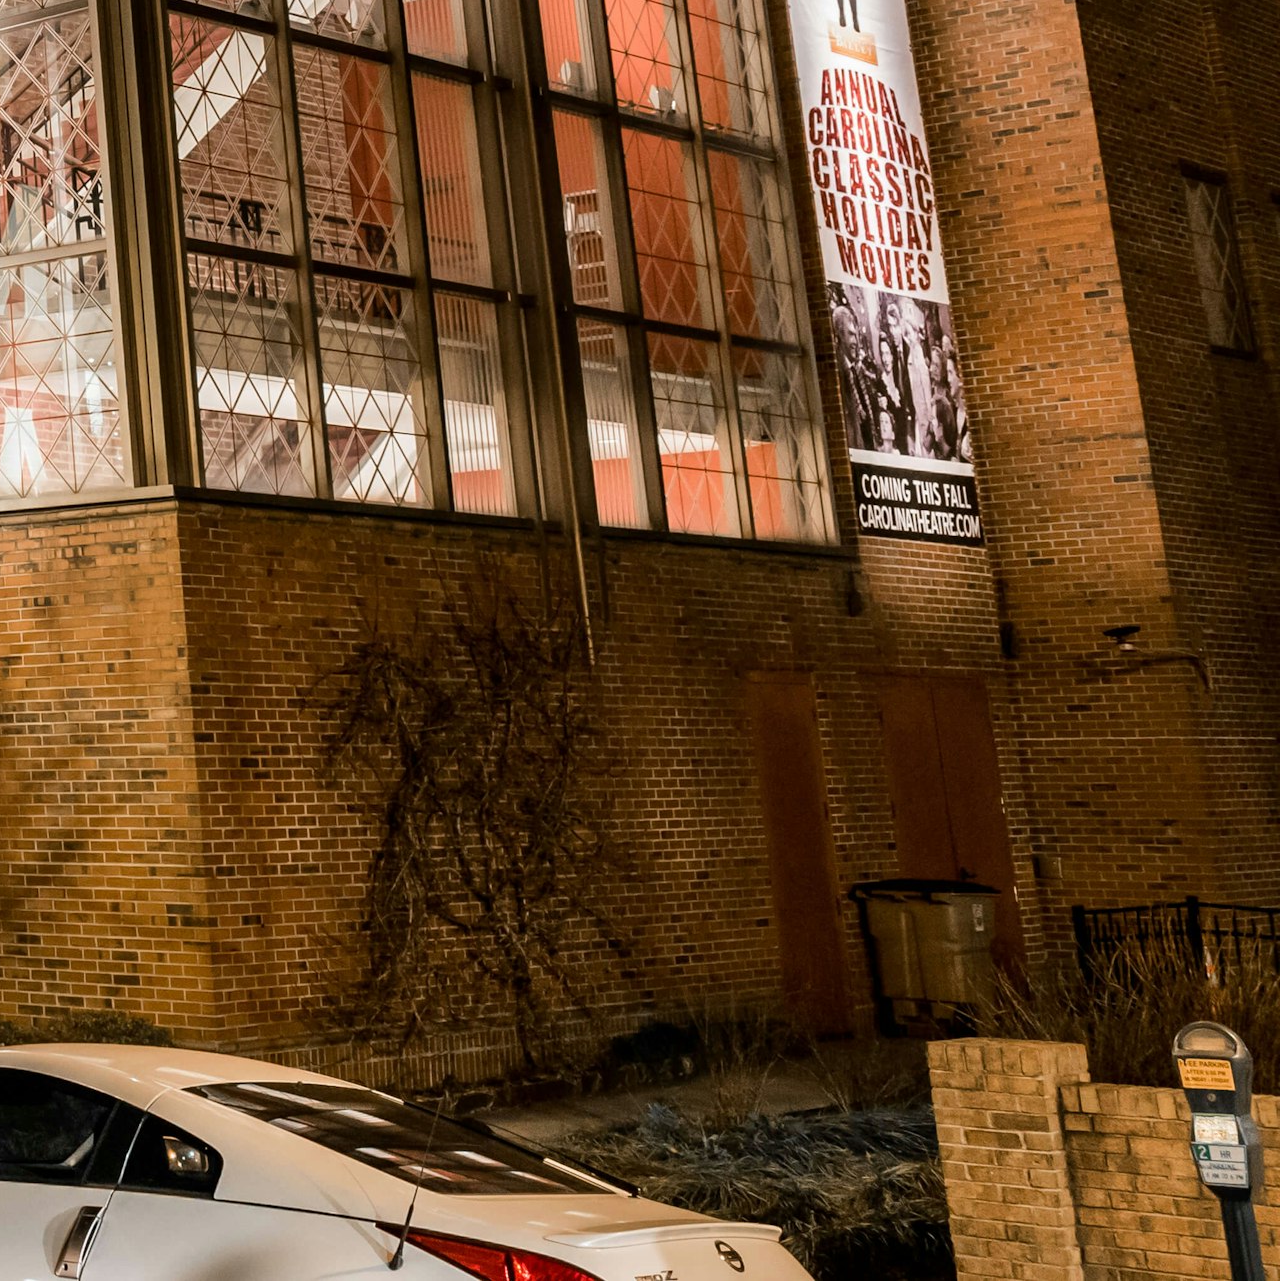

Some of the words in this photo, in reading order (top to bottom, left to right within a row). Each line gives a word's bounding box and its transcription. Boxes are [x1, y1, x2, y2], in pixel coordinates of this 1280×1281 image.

[821, 68, 907, 129] ANNUAL
[808, 106, 930, 176] CAROLINA
[812, 147, 933, 215] CLASSIC
[820, 189, 933, 252] HOLIDAY
[835, 233, 931, 293] MOVIES
[858, 503, 981, 538] CAROLINATHEATRE.COM
[861, 473, 912, 503] COMING
[912, 479, 941, 506] THIS
[943, 483, 972, 509] FALL
[1200, 1061, 1230, 1069] PARKING
[1198, 1146, 1208, 1159] 2
[1220, 1150, 1232, 1159] HR
